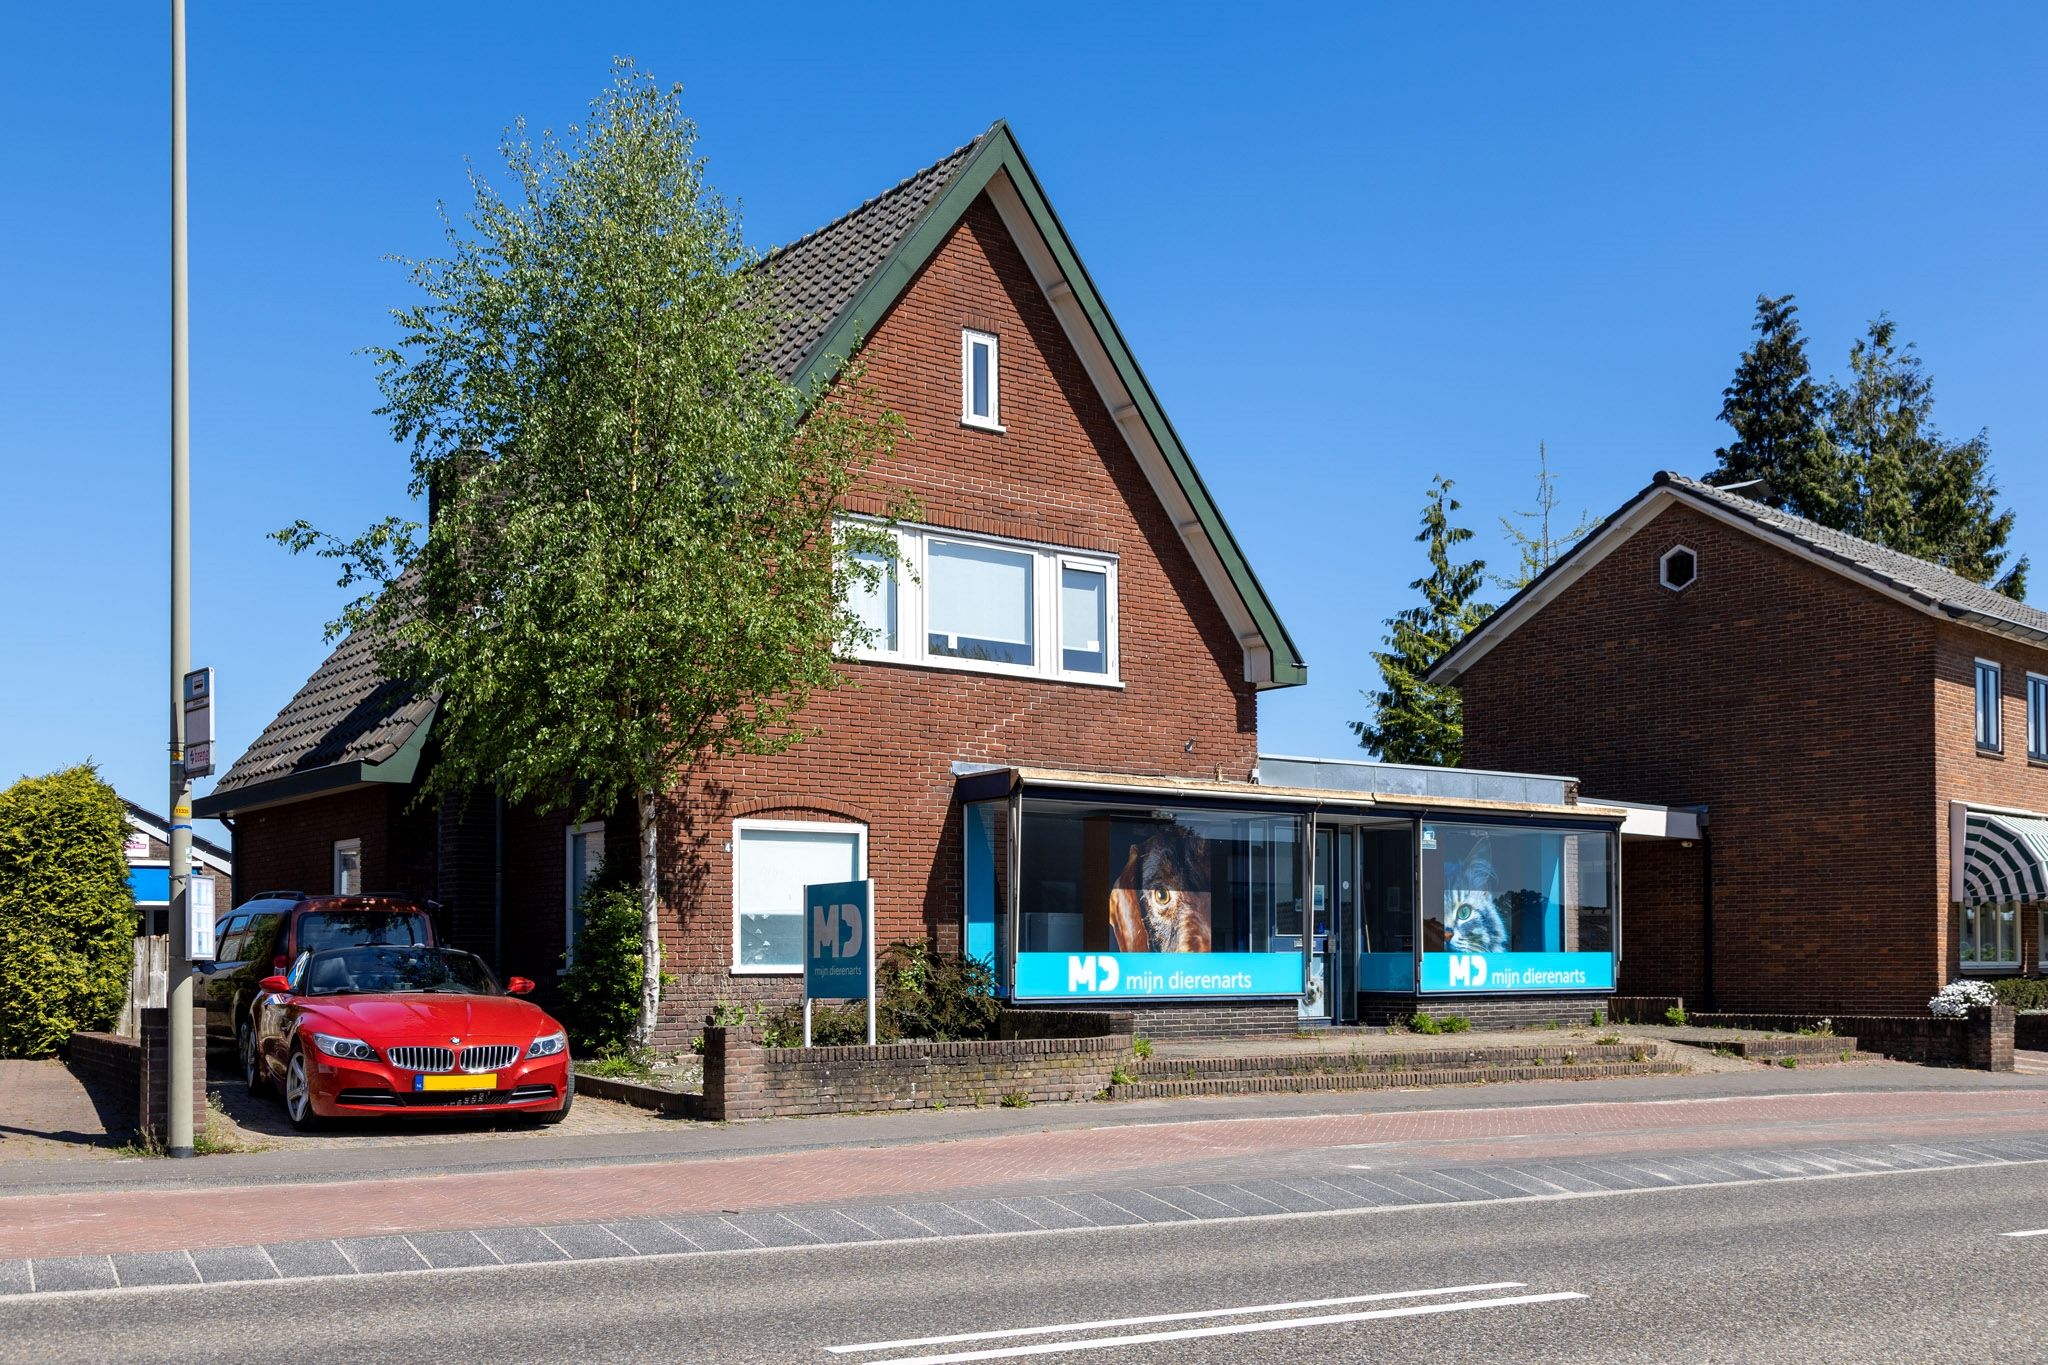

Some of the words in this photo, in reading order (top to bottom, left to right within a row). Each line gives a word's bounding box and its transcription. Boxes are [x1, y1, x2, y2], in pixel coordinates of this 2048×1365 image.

[813, 904, 863, 958] MD
[814, 966, 828, 978] mijn
[829, 965, 862, 976] dierenarts
[1068, 955, 1120, 992] MD
[1126, 971, 1163, 993] mijn
[1168, 970, 1252, 990] dierenarts
[1449, 955, 1487, 987] MD
[1491, 969, 1520, 988] mijn
[1523, 968, 1586, 985] dierenarts
